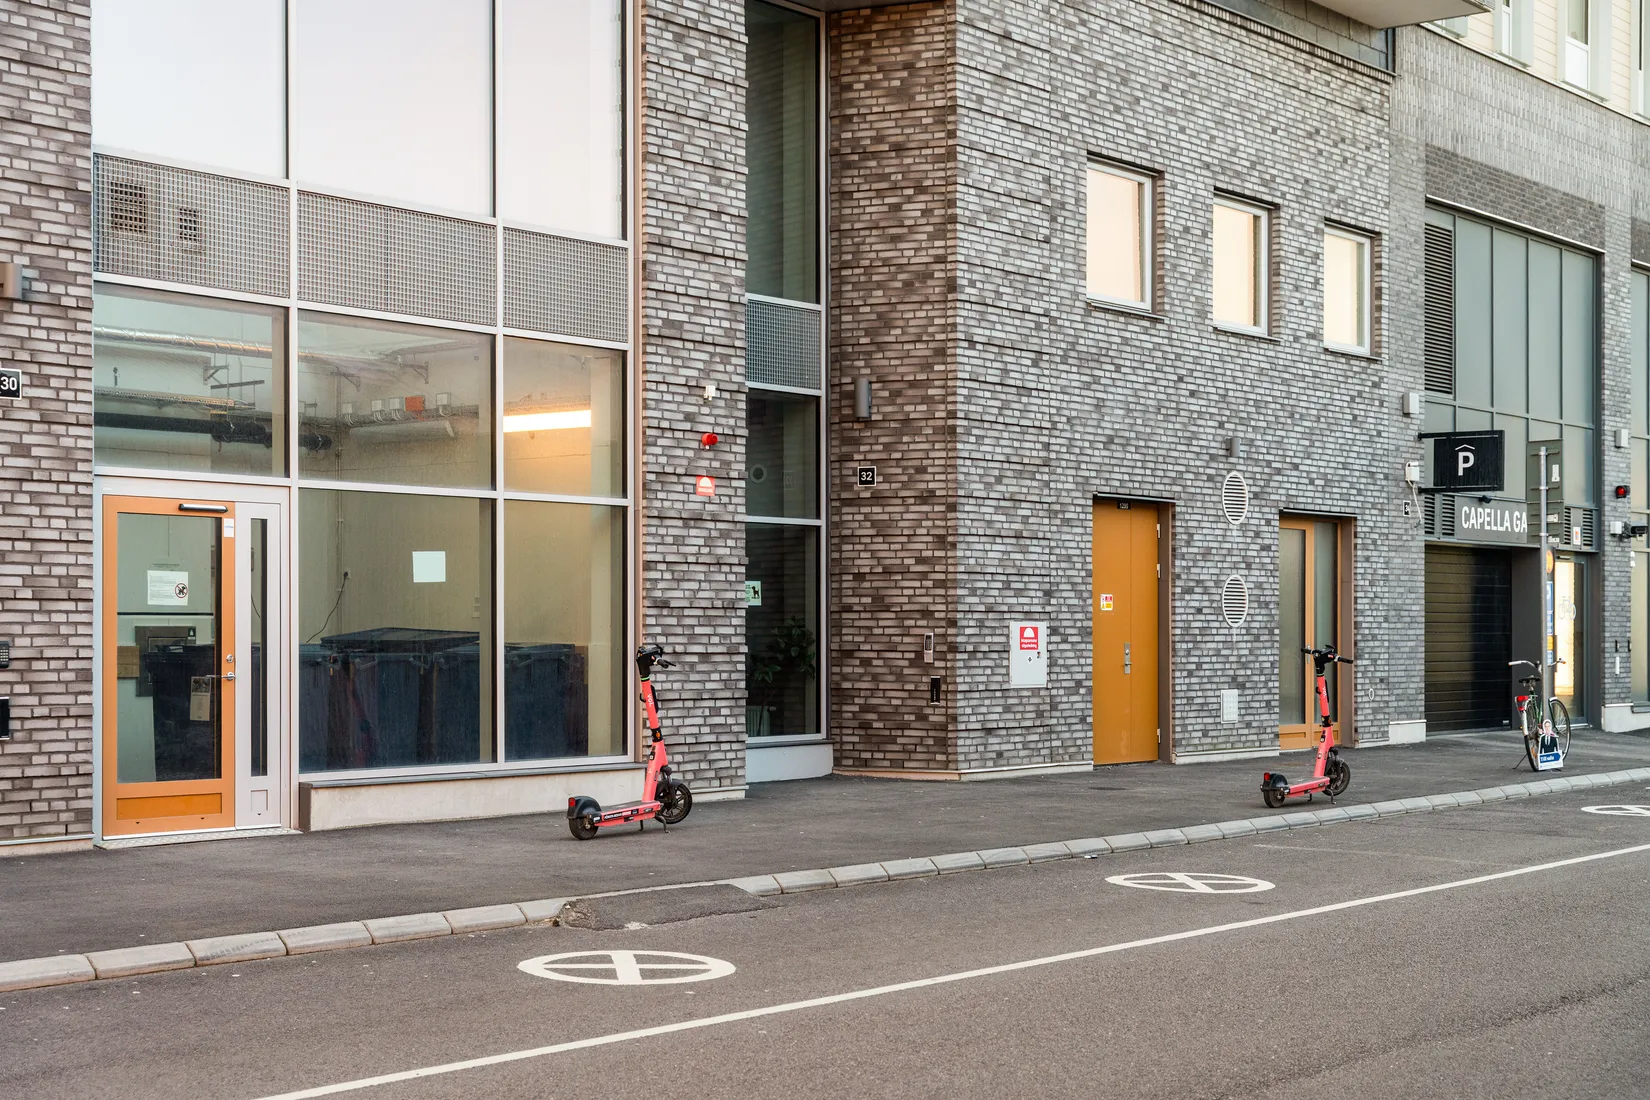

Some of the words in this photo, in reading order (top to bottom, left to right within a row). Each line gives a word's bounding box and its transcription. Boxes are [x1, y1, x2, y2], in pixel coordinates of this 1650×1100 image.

[0, 376, 18, 391] 30
[1457, 451, 1475, 476] P
[860, 471, 873, 481] 32
[1461, 505, 1512, 532] CAPELLA
